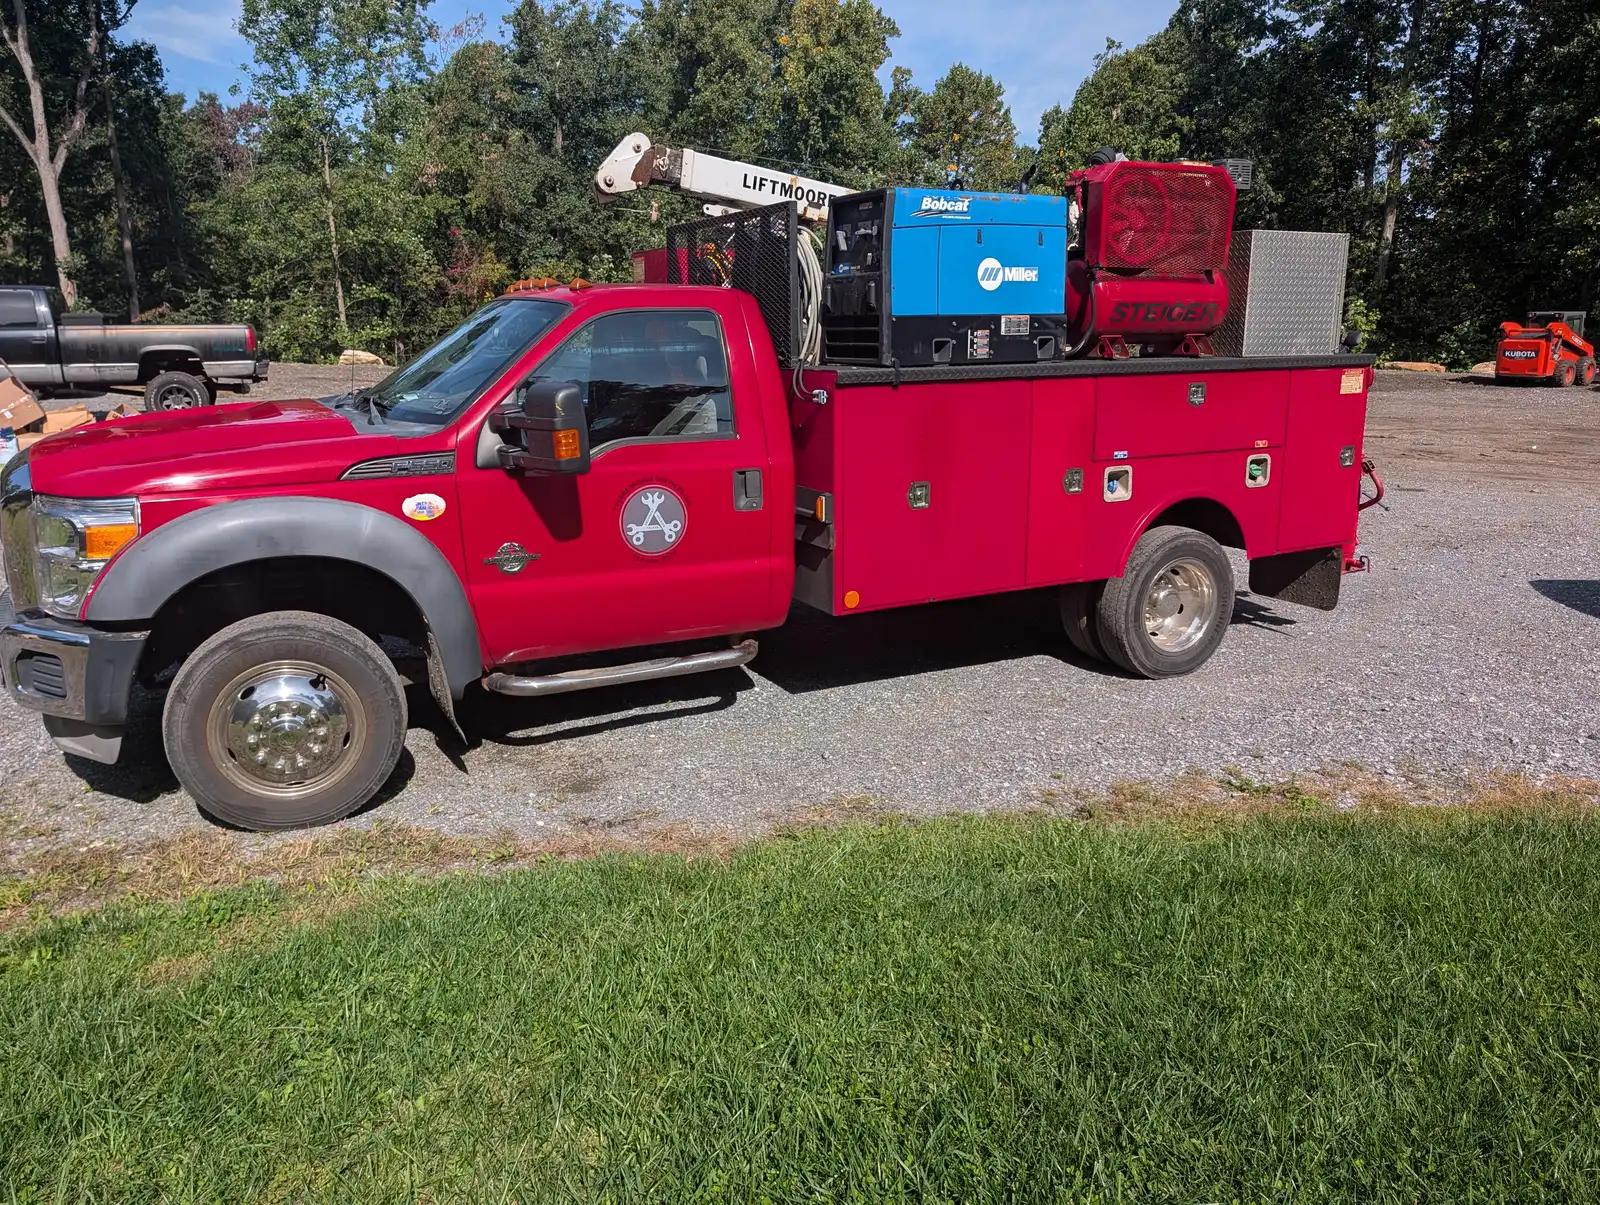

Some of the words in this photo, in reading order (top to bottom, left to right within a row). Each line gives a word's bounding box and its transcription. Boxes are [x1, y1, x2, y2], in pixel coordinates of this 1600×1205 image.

[921, 196, 970, 212] Bobcat
[1004, 267, 1038, 281] Miller
[1109, 302, 1219, 322] STEIGER
[1504, 350, 1536, 358] KUBOTA
